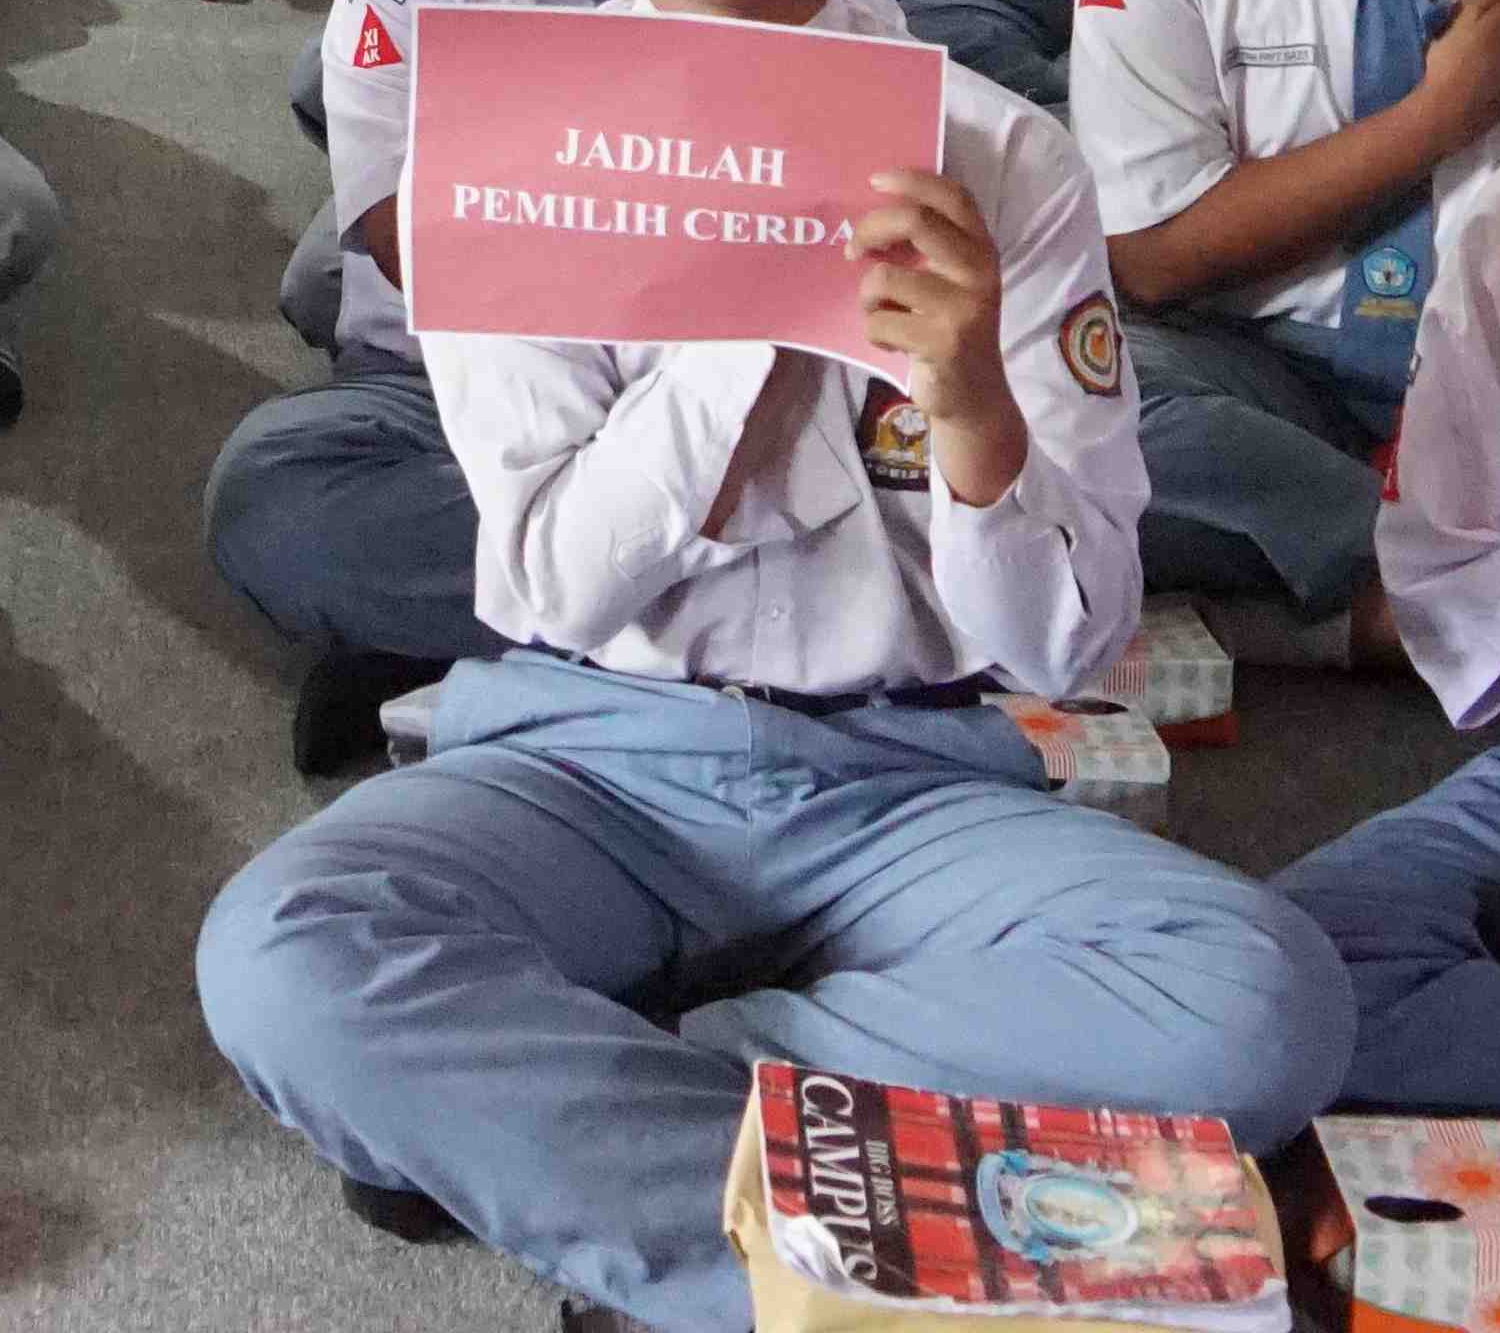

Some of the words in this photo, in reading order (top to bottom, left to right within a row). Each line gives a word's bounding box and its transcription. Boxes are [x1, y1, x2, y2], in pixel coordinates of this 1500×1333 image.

[363, 27, 379, 48] XI
[363, 47, 381, 66] AK
[555, 126, 785, 188] JADILAH
[452, 183, 668, 237] PEMILIH
[682, 207, 853, 247] CERDA
